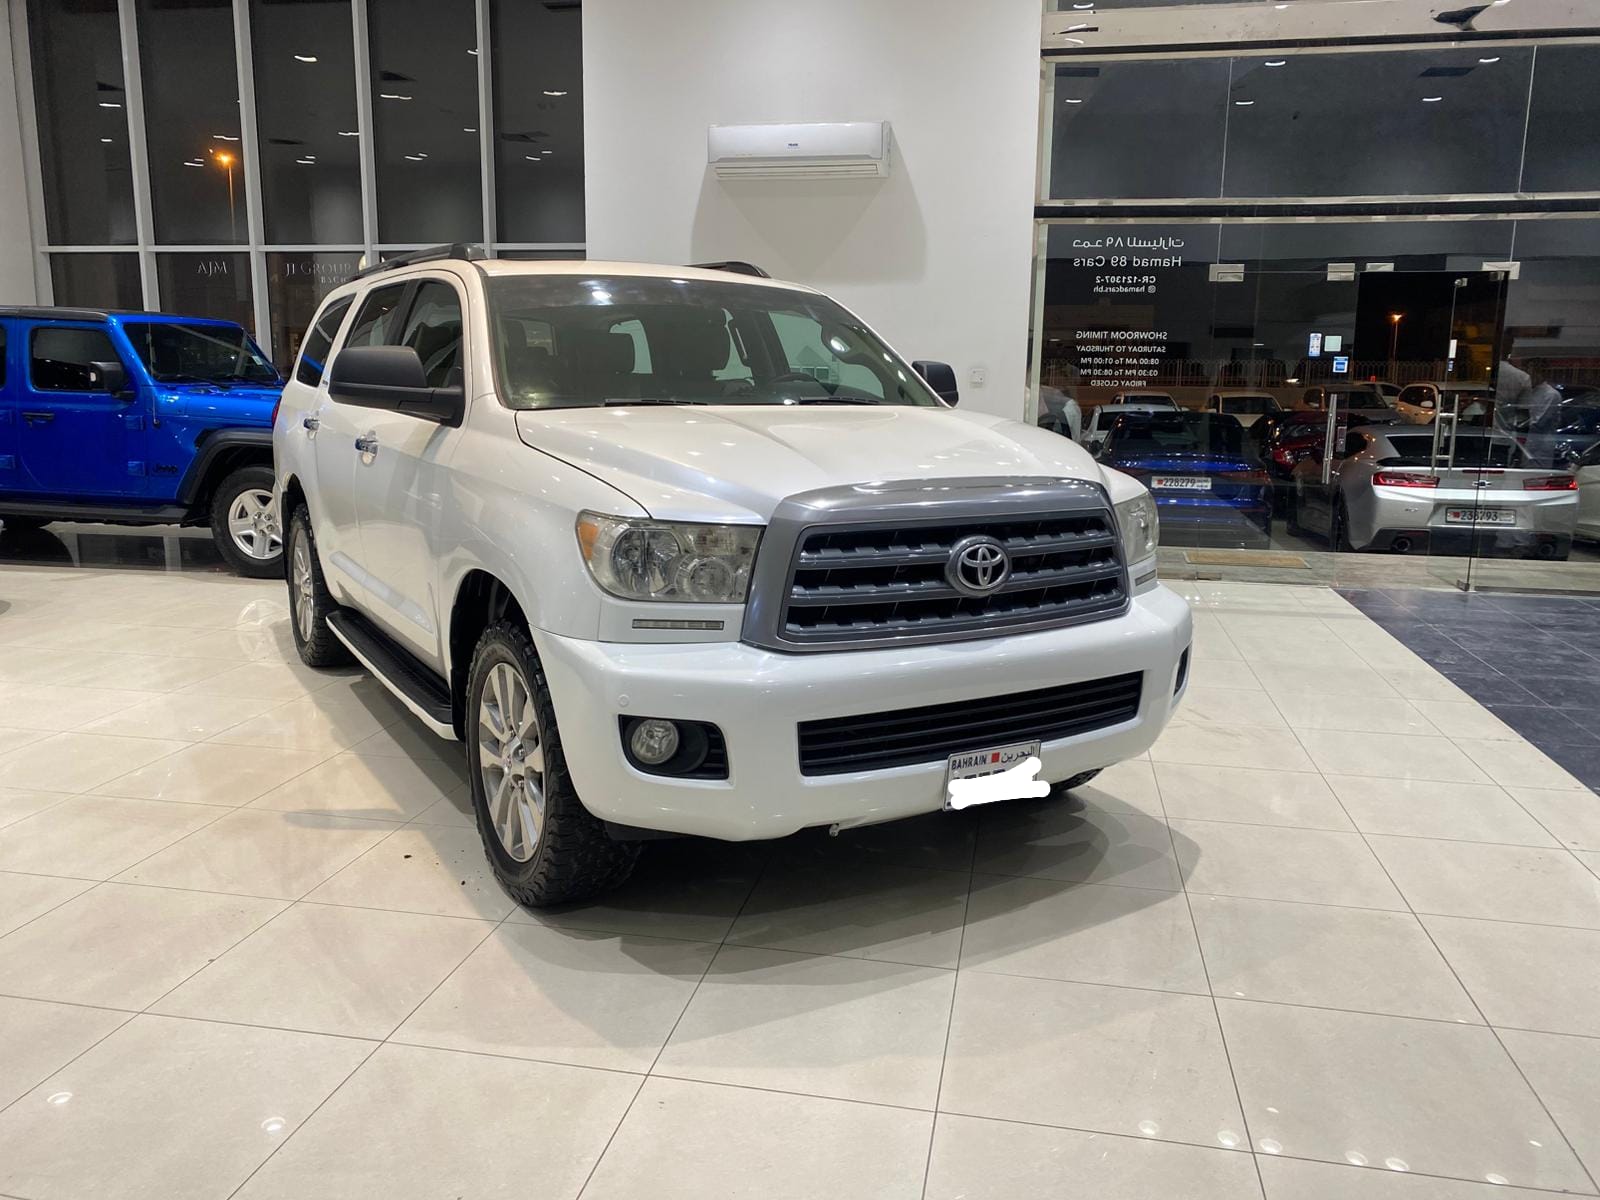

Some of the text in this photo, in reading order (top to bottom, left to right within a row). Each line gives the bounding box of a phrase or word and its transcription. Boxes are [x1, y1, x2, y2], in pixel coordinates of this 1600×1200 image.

[197, 261, 228, 277] AJM
[300, 262, 352, 276] GROUP
[1163, 477, 1196, 488] 228279
[951, 754, 988, 770] BAHRAIN
